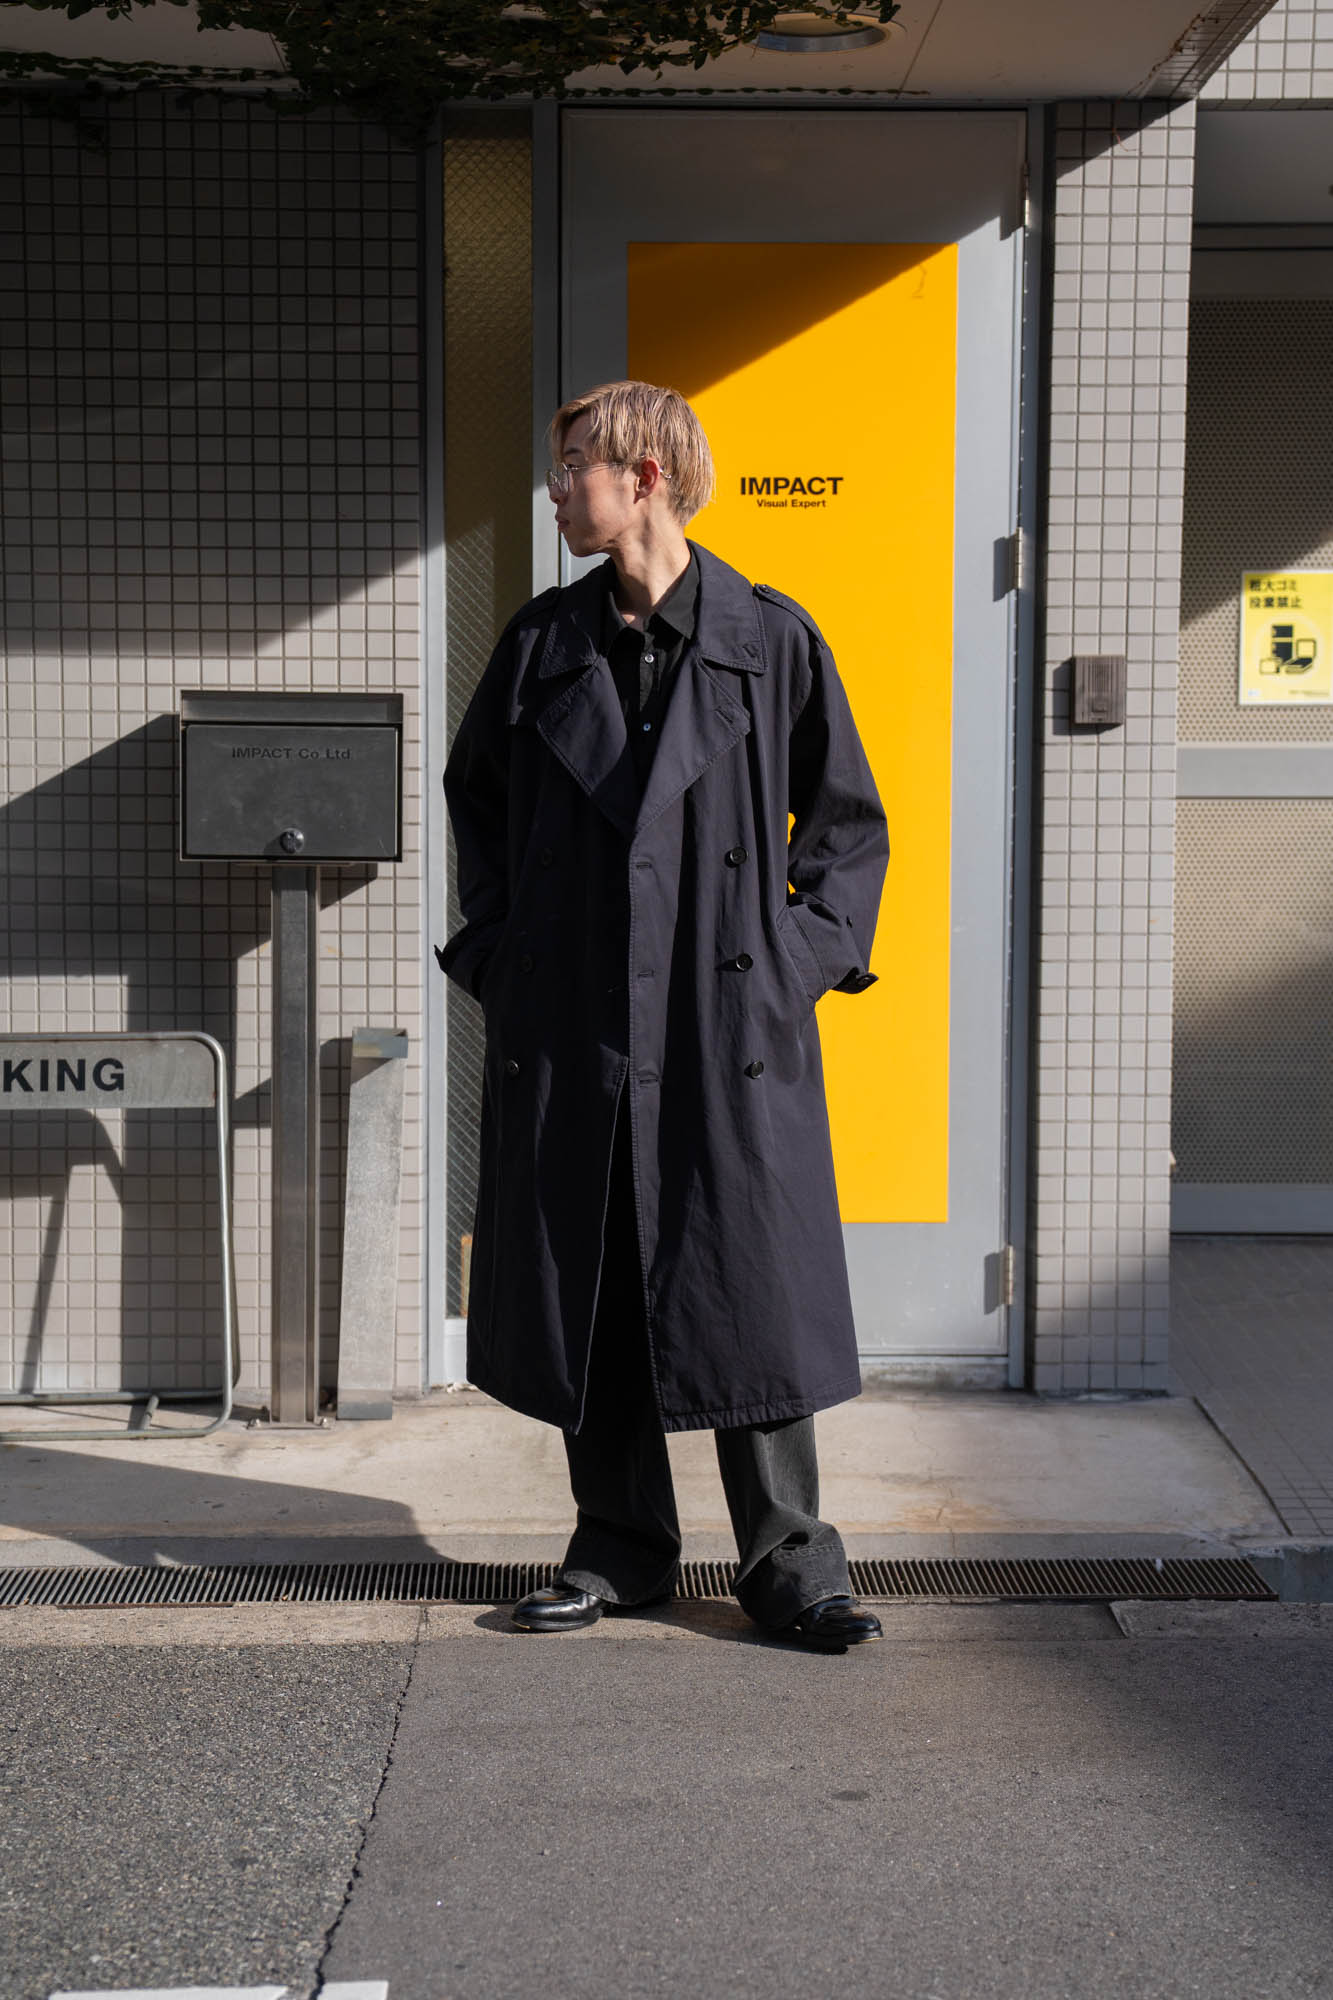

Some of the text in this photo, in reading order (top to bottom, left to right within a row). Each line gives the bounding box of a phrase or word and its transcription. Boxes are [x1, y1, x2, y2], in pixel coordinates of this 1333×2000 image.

[740, 476, 844, 496] IMPACT
[756, 499, 827, 510] Visual Expert
[231, 746, 293, 759] IMPACT
[3, 1057, 125, 1092] KING
